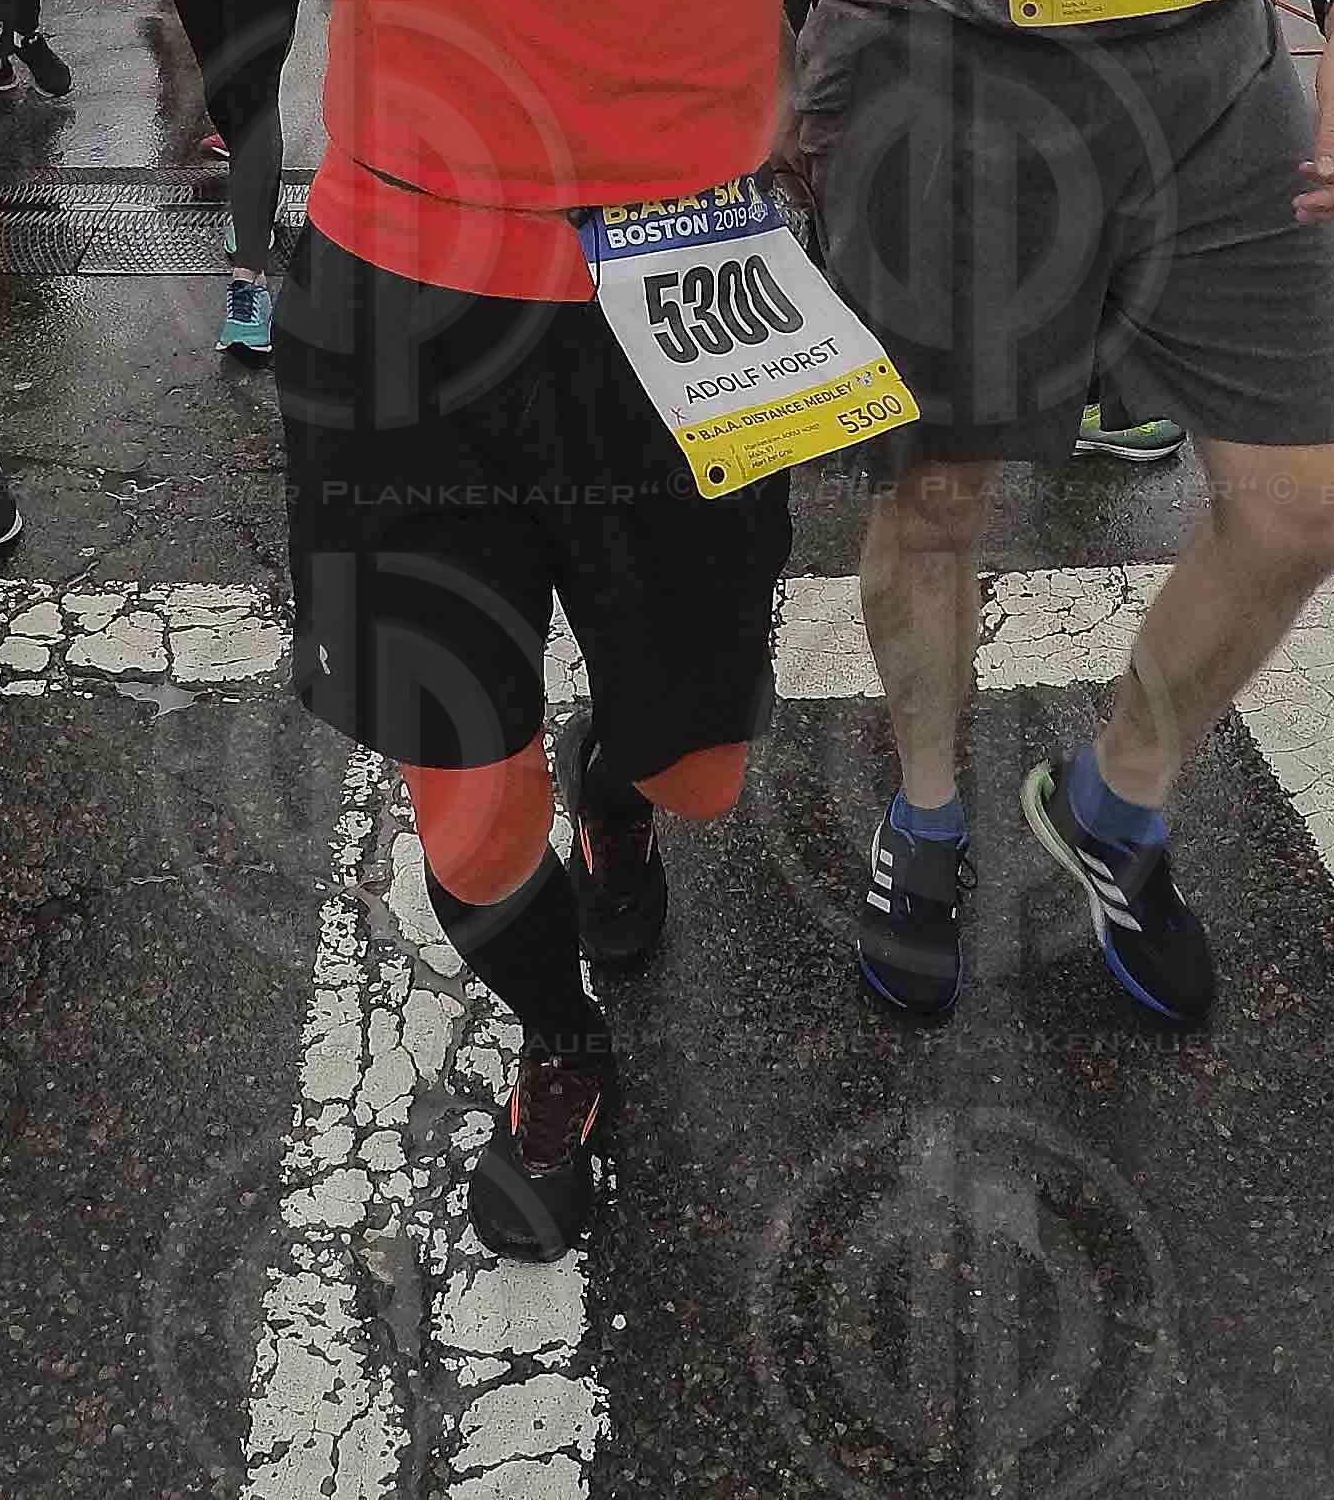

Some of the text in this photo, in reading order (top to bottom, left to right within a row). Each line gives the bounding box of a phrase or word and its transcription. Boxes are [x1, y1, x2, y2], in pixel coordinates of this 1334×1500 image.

[606, 207, 748, 250] BOSTON 2019
[643, 254, 805, 364] 5300
[684, 336, 842, 405] ADOLF HORST
[698, 380, 854, 441] B.A.A. DISTANCE MEDLEY
[836, 394, 903, 435] 5300
